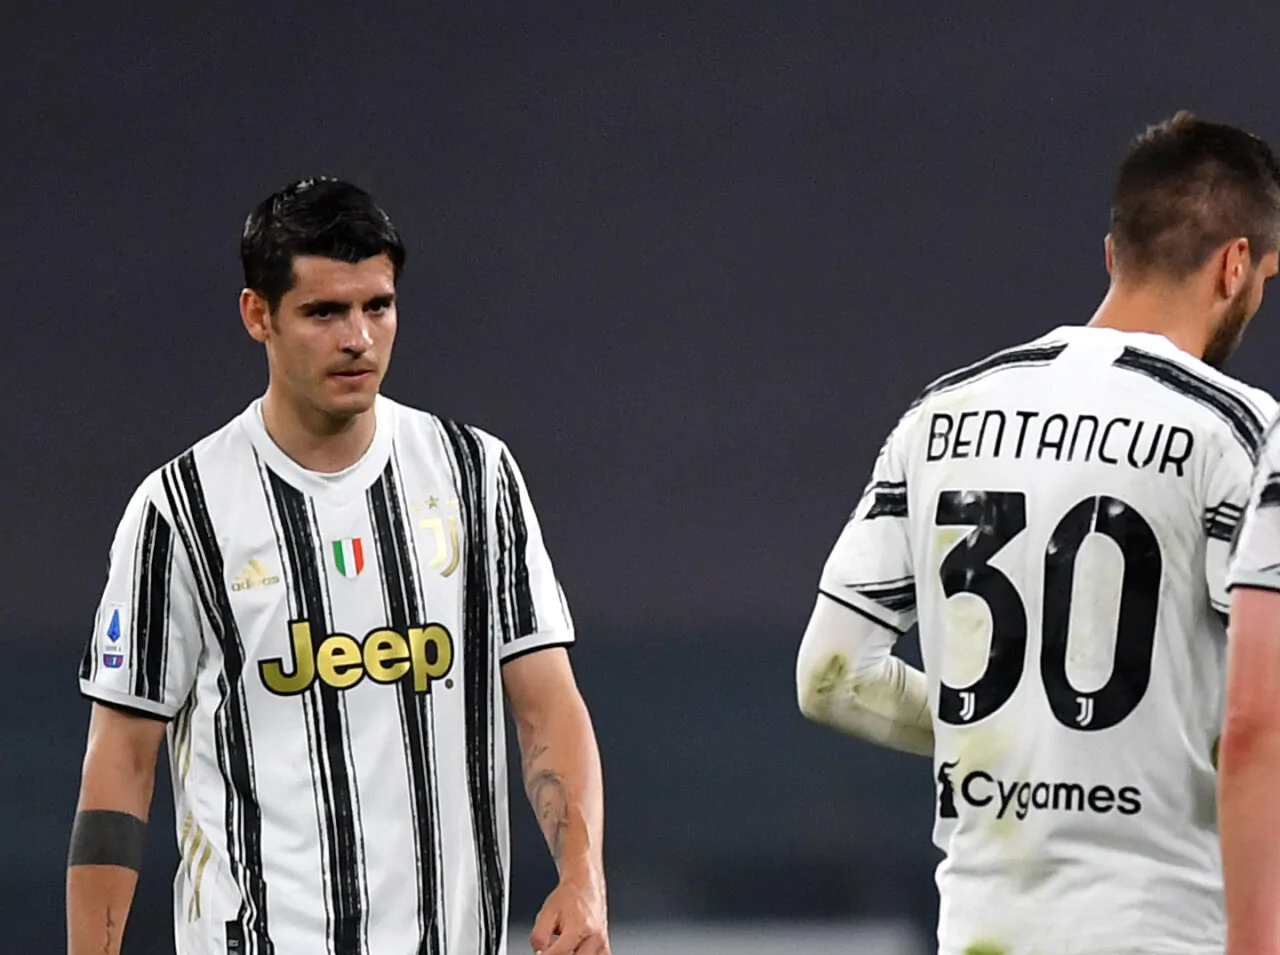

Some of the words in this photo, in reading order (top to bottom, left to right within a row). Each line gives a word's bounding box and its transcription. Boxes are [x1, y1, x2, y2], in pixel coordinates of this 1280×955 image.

[926, 410, 1194, 477] BENTANCUR
[934, 489, 1163, 732] 30
[257, 619, 454, 697] Jeep
[960, 770, 1142, 820] Cygames
